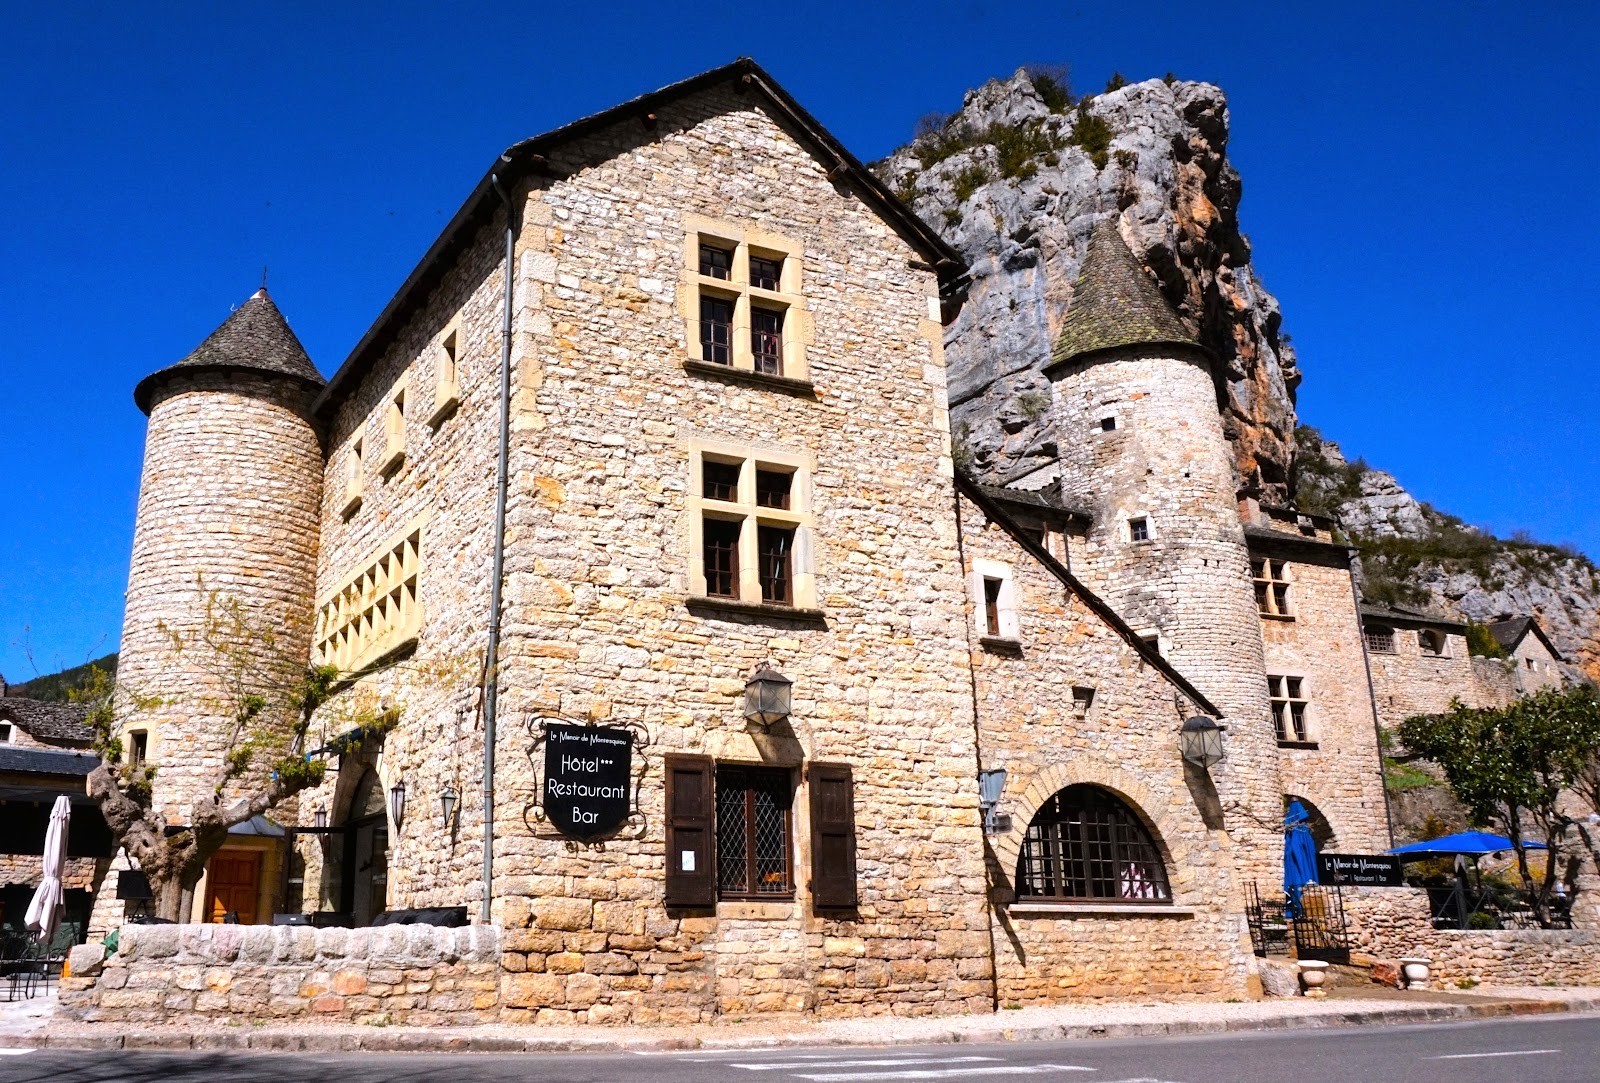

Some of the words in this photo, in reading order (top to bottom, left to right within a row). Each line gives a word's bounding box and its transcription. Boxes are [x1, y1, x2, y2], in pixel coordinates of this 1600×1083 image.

[551, 731, 557, 741] Le
[560, 731, 580, 743] Manoir
[581, 733, 589, 741] de
[590, 734, 626, 746] Montesquiou
[548, 779, 625, 798] Restaurant
[572, 807, 599, 823] Bar
[1325, 858, 1331, 870] Le
[1333, 858, 1352, 872] Manoir
[1352, 859, 1359, 868] de
[1360, 859, 1391, 873] Montesquiou
